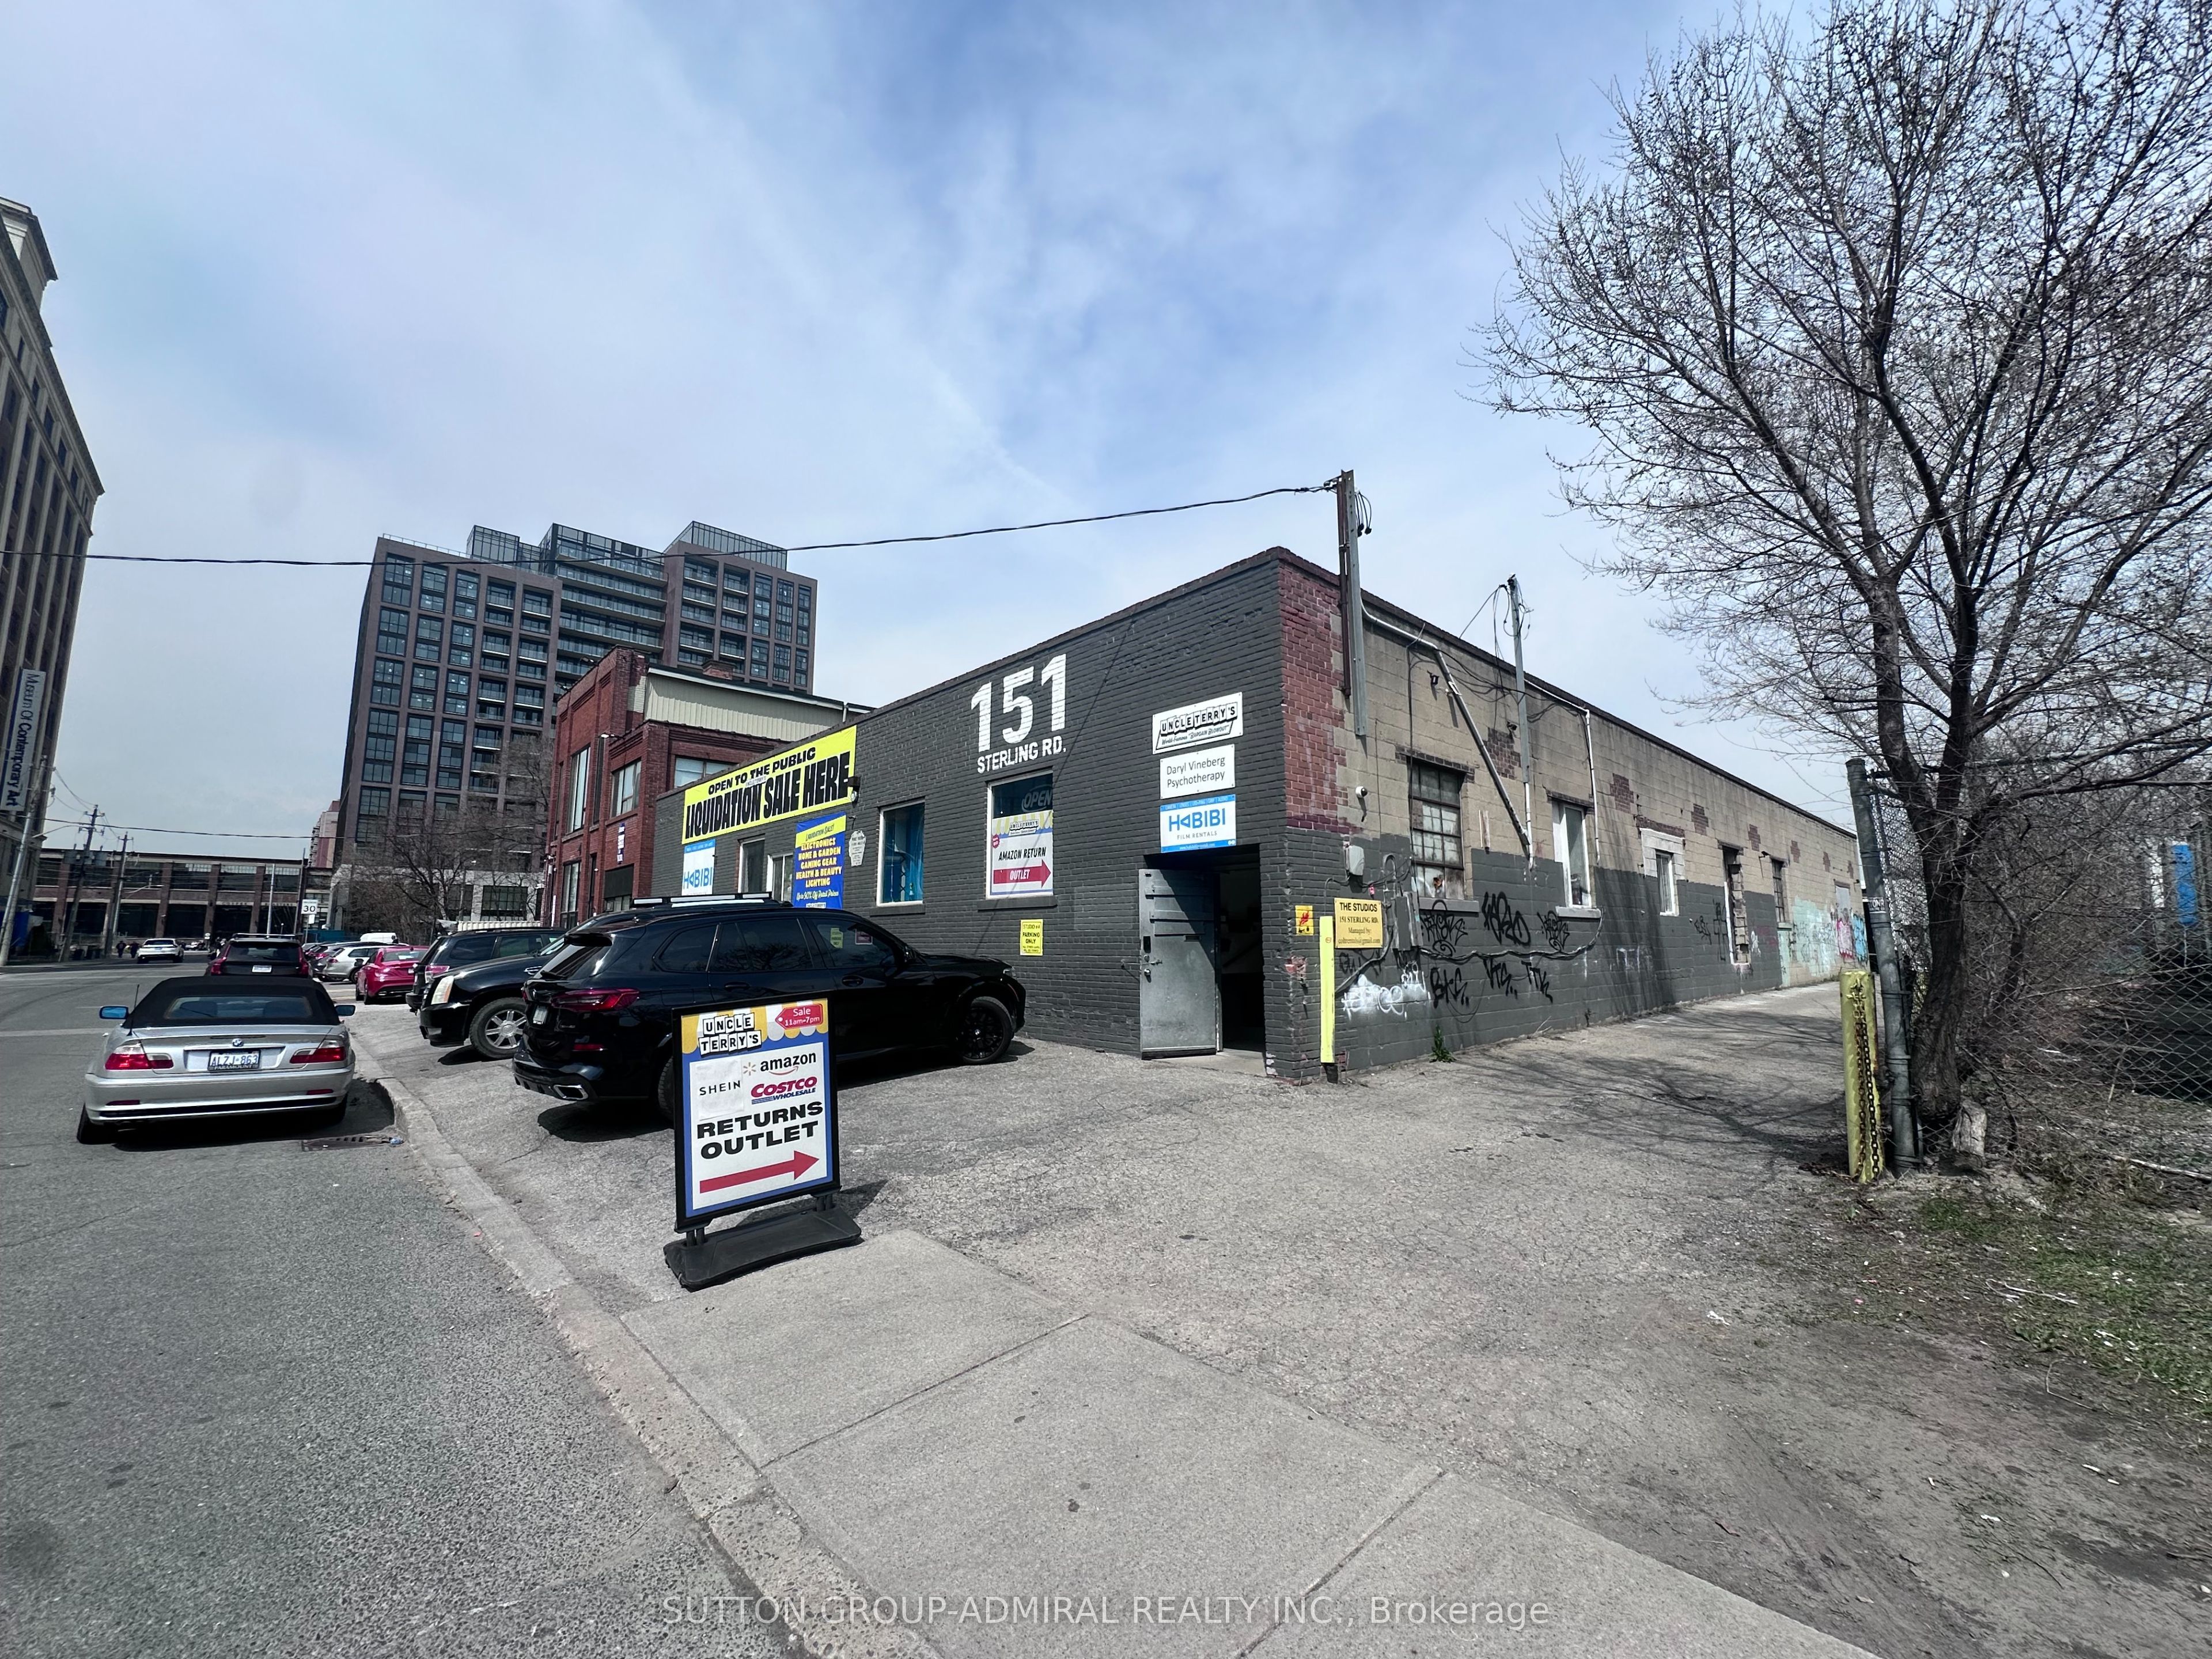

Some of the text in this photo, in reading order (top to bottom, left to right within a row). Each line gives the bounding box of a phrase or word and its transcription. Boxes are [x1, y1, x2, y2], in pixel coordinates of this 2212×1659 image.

[22, 673, 40, 708] Museum
[971, 653, 1066, 752] 151
[1162, 706, 1235, 732] UNCLE TERRY'S
[7, 722, 32, 787] Contemporary
[978, 736, 1066, 774] STERLING RD.
[708, 778, 733, 795] OPEN
[734, 772, 747, 786] TO
[750, 764, 770, 778] THE
[772, 747, 816, 772] PUBLIC
[1166, 757, 1225, 775] Daryl Vineberg
[1167, 771, 1225, 789] Psychotherapy
[6, 790, 21, 806] Art
[685, 783, 762, 839] LIQUIDATION
[763, 769, 800, 819] SALE
[802, 751, 851, 808] HERE
[1024, 789, 1053, 809] OPEN
[801, 837, 836, 851] ELECTRONICS
[798, 852, 813, 861] HOME
[819, 846, 841, 857] GARDEN
[998, 846, 1047, 861] AMAZON RETURN
[801, 857, 837, 869] GAMING GEAR
[796, 866, 842, 880] HEALTH & BEAUTY
[1009, 869, 1031, 881] OUTLET
[805, 877, 831, 888] LIGHTING
[1339, 902, 1378, 912] THE STUDIOS
[706, 1007, 811, 1032] UNCLE Sale
[785, 1016, 820, 1027] 11am-7pm
[700, 1035, 759, 1052] TERRY'S
[241, 1055, 259, 1065] 863
[760, 1052, 816, 1072] amazon
[699, 1080, 741, 1096] SHEIN
[751, 1076, 817, 1097] COSTCO
[772, 1087, 816, 1101] WHOLESALE
[697, 1101, 823, 1139] RETURNS
[700, 1121, 819, 1159] OUTLET
